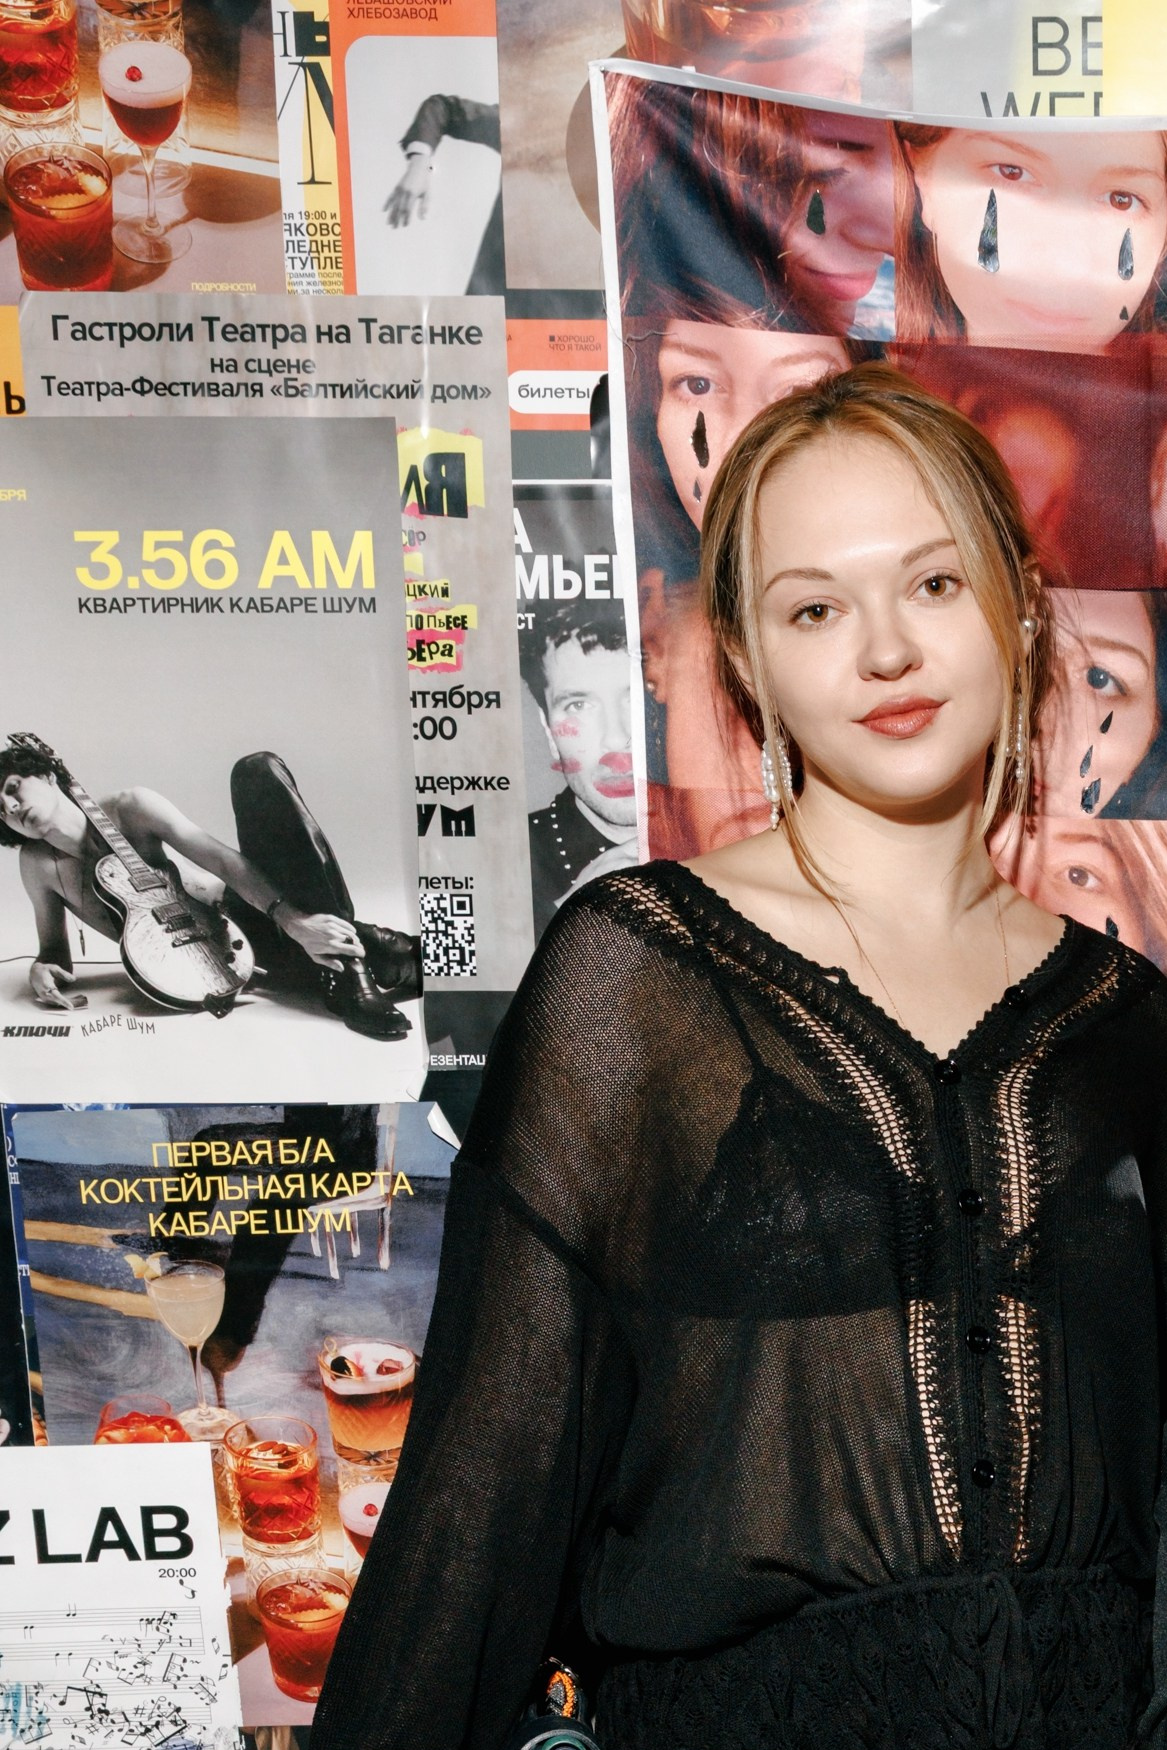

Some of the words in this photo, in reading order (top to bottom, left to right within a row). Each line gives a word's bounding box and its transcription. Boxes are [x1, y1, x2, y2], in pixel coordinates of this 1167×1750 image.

[347, 7, 438, 21] ХЛЕБОЗАВОД
[298, 211, 327, 220] 19:00
[285, 239, 343, 256] ЛЕДНЕ
[286, 256, 343, 270] ТУПЛЕ
[52, 315, 194, 348] Гастроли
[201, 316, 307, 349] Театра
[316, 322, 351, 344] на
[358, 318, 483, 345] Таганке
[210, 358, 238, 373] на
[245, 358, 316, 377] сцене
[41, 375, 264, 401] Театра-Фестиваля
[271, 376, 424, 400] «Балтийский
[430, 381, 492, 404] дом»
[518, 384, 591, 399] билеты
[73, 529, 239, 590] 3.56
[78, 597, 225, 614] КВАРТИРНИК
[230, 597, 317, 614] КАБАРЕ
[322, 597, 377, 614] ШУМ
[81, 1014, 122, 1037] КАБАРЕ
[126, 1017, 155, 1034] ШУМ
[152, 1138, 274, 1168] ПЕРВАЯ
[279, 1136, 336, 1165] Б/А
[80, 1173, 306, 1204] КОКТЕЙЛЬНАЯ
[311, 1171, 414, 1199] КАРТА
[148, 1210, 269, 1238] КАБАРЕ
[274, 1207, 351, 1234] ШУМ
[32, 1505, 194, 1564] LAB
[158, 1568, 197, 1579] 20:00
